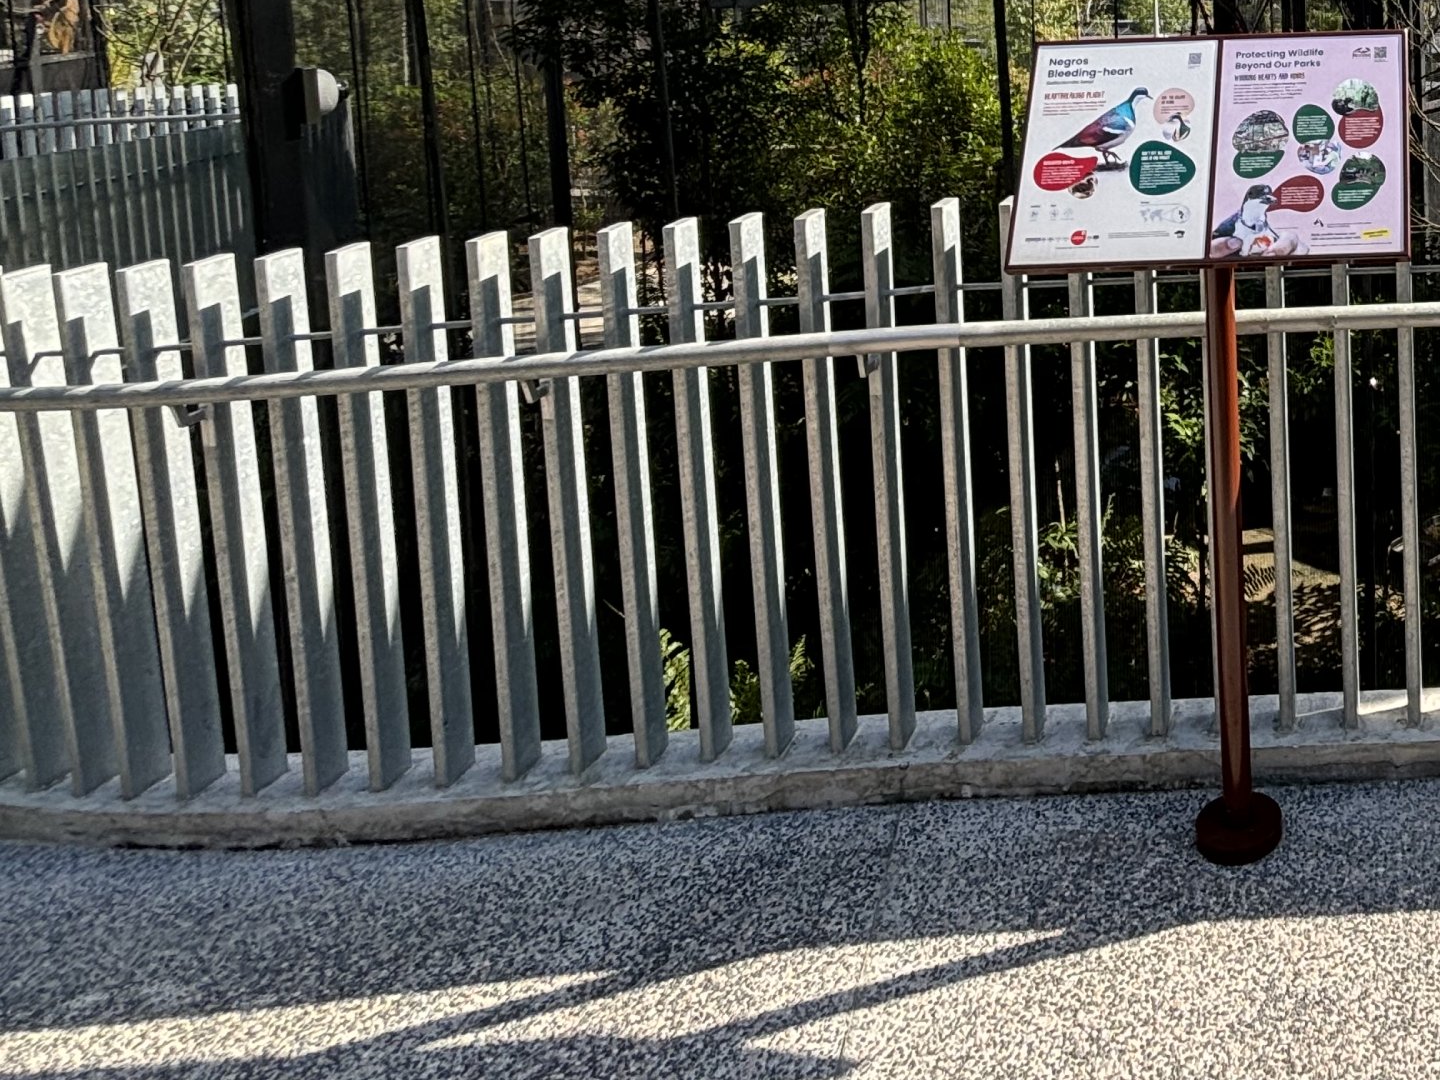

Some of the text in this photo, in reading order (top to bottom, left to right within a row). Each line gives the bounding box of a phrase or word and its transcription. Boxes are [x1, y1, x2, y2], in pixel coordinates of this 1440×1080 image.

[1235, 48, 1324, 60] Protecting Wildlife
[1049, 58, 1089, 68] Negros
[1235, 59, 1321, 72] Beyond Our Parks
[1047, 67, 1134, 79] Bleeding-heart
